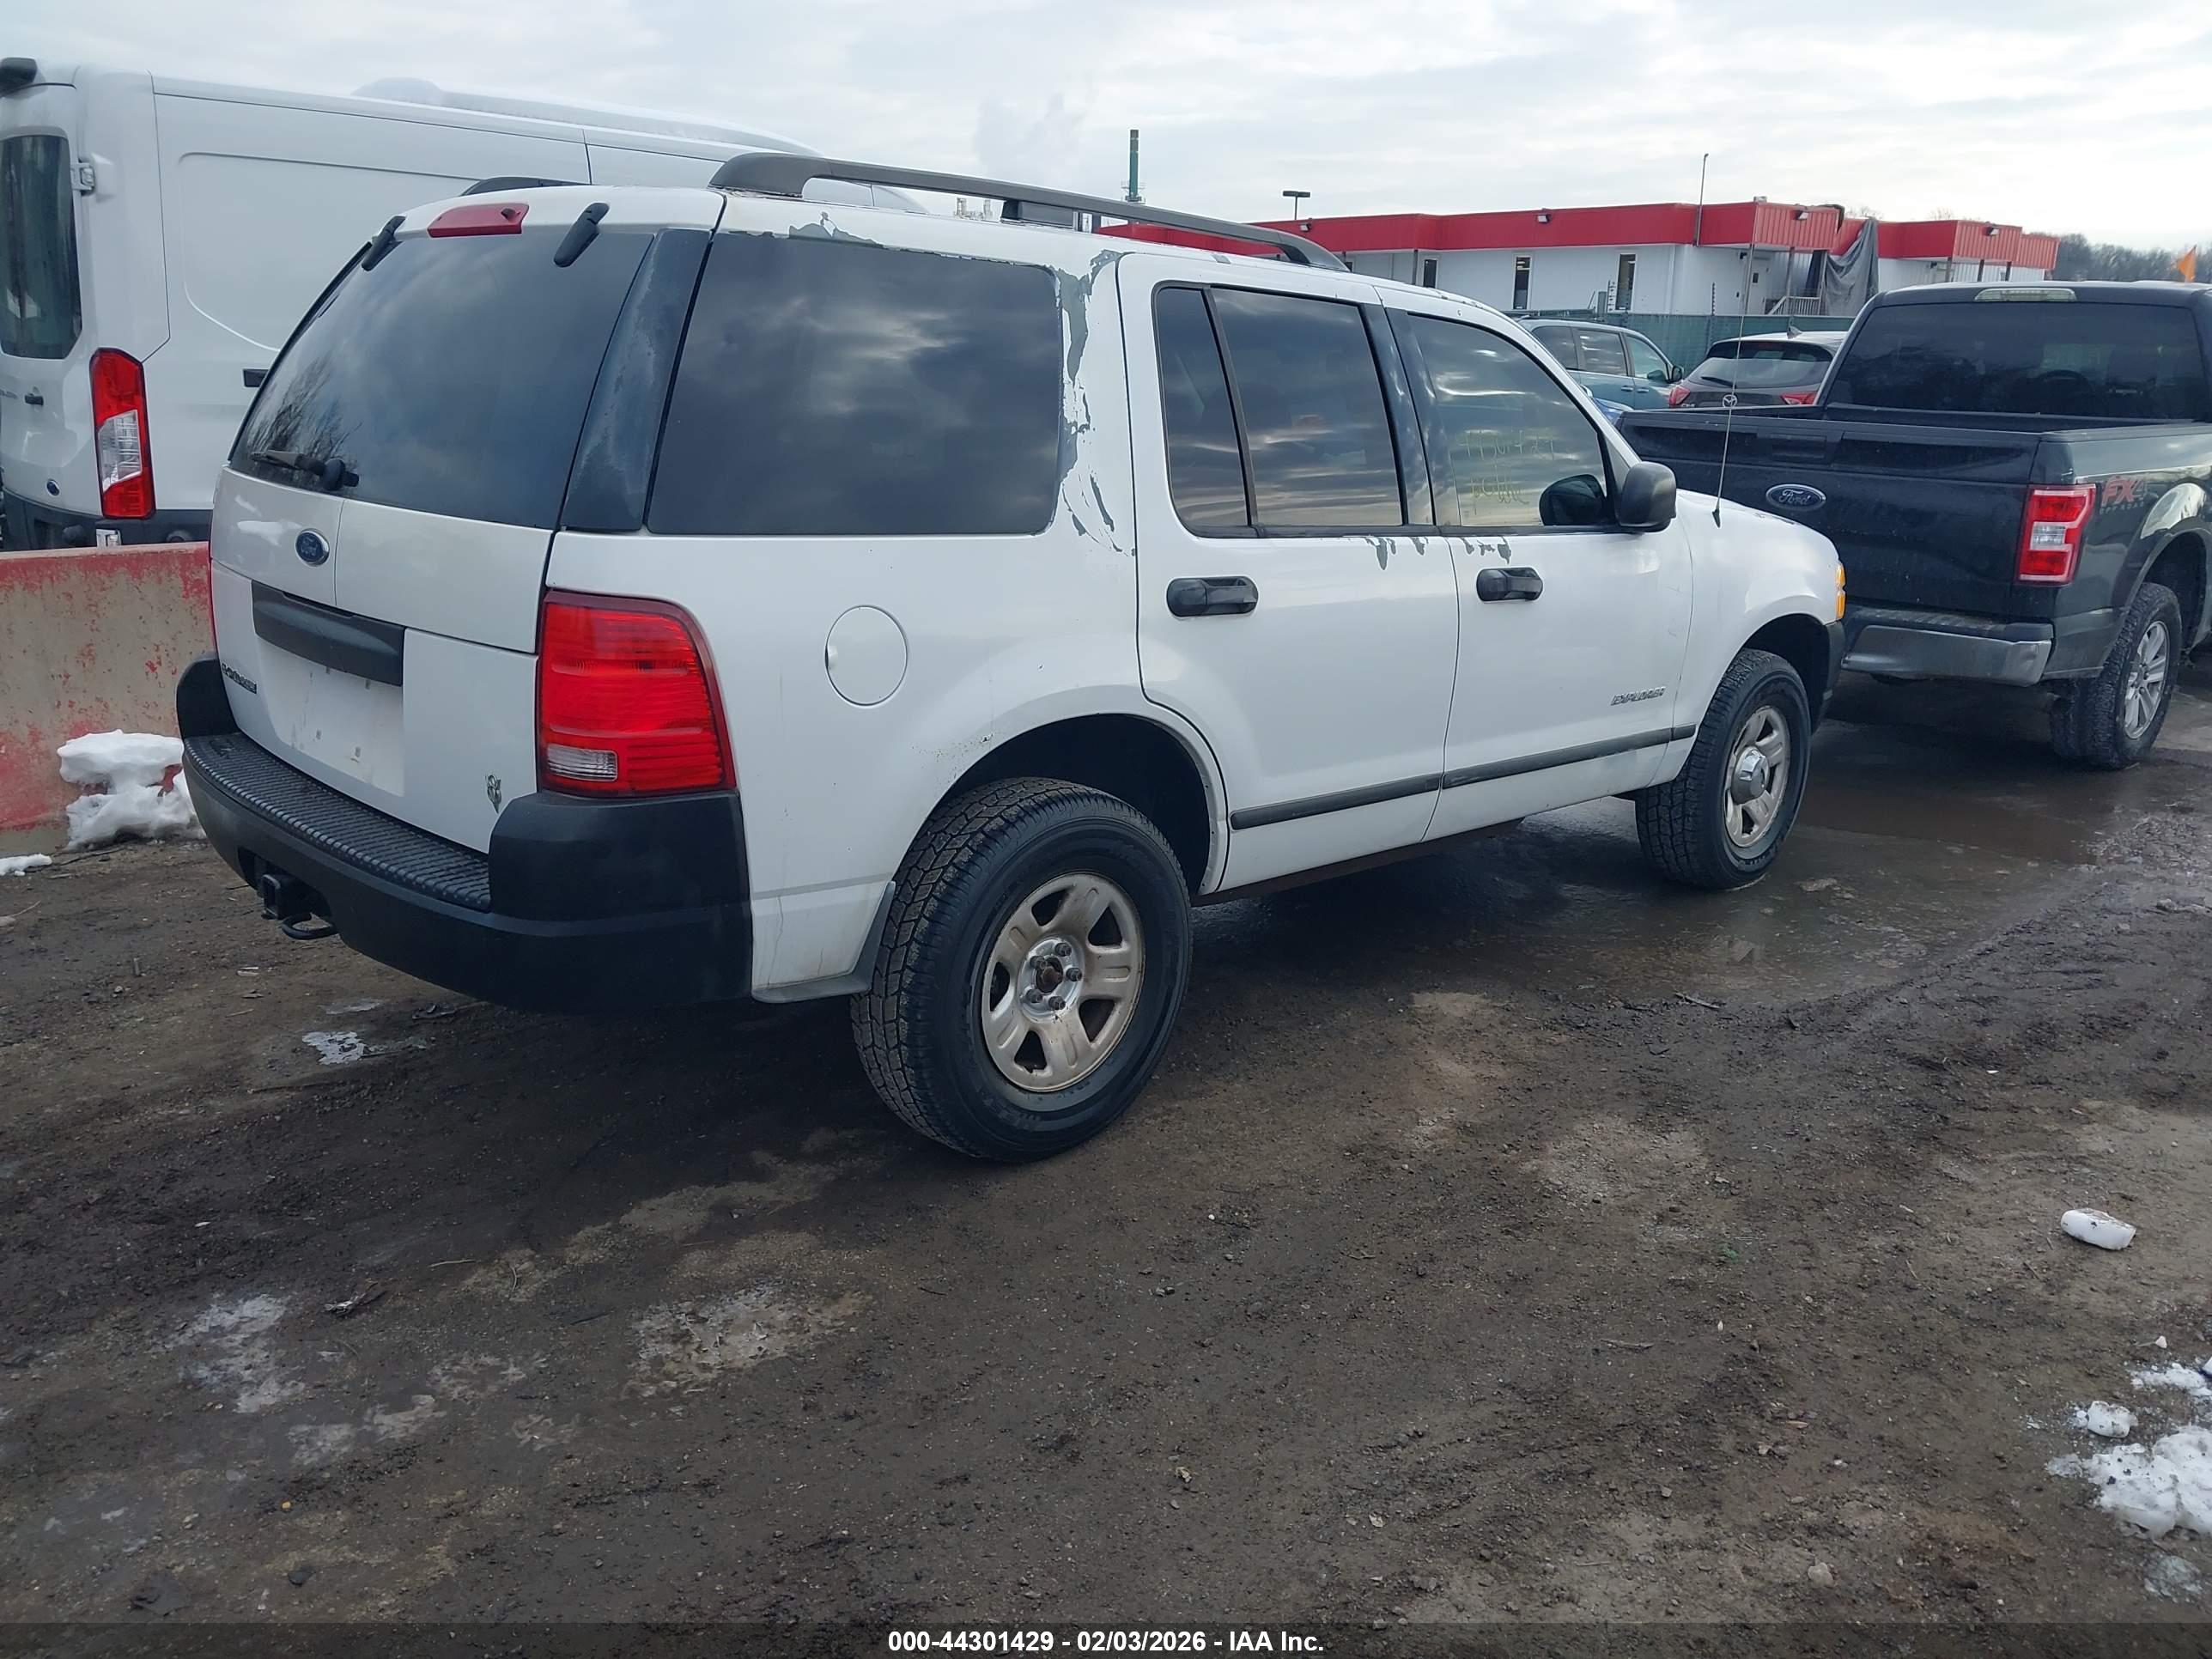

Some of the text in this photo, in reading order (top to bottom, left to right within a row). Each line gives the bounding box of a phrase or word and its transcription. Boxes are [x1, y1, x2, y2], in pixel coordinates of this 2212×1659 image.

[1778, 489, 1810, 506] Ford
[2101, 476, 2148, 507] FX4
[1610, 686, 1667, 706] EXPLORER
